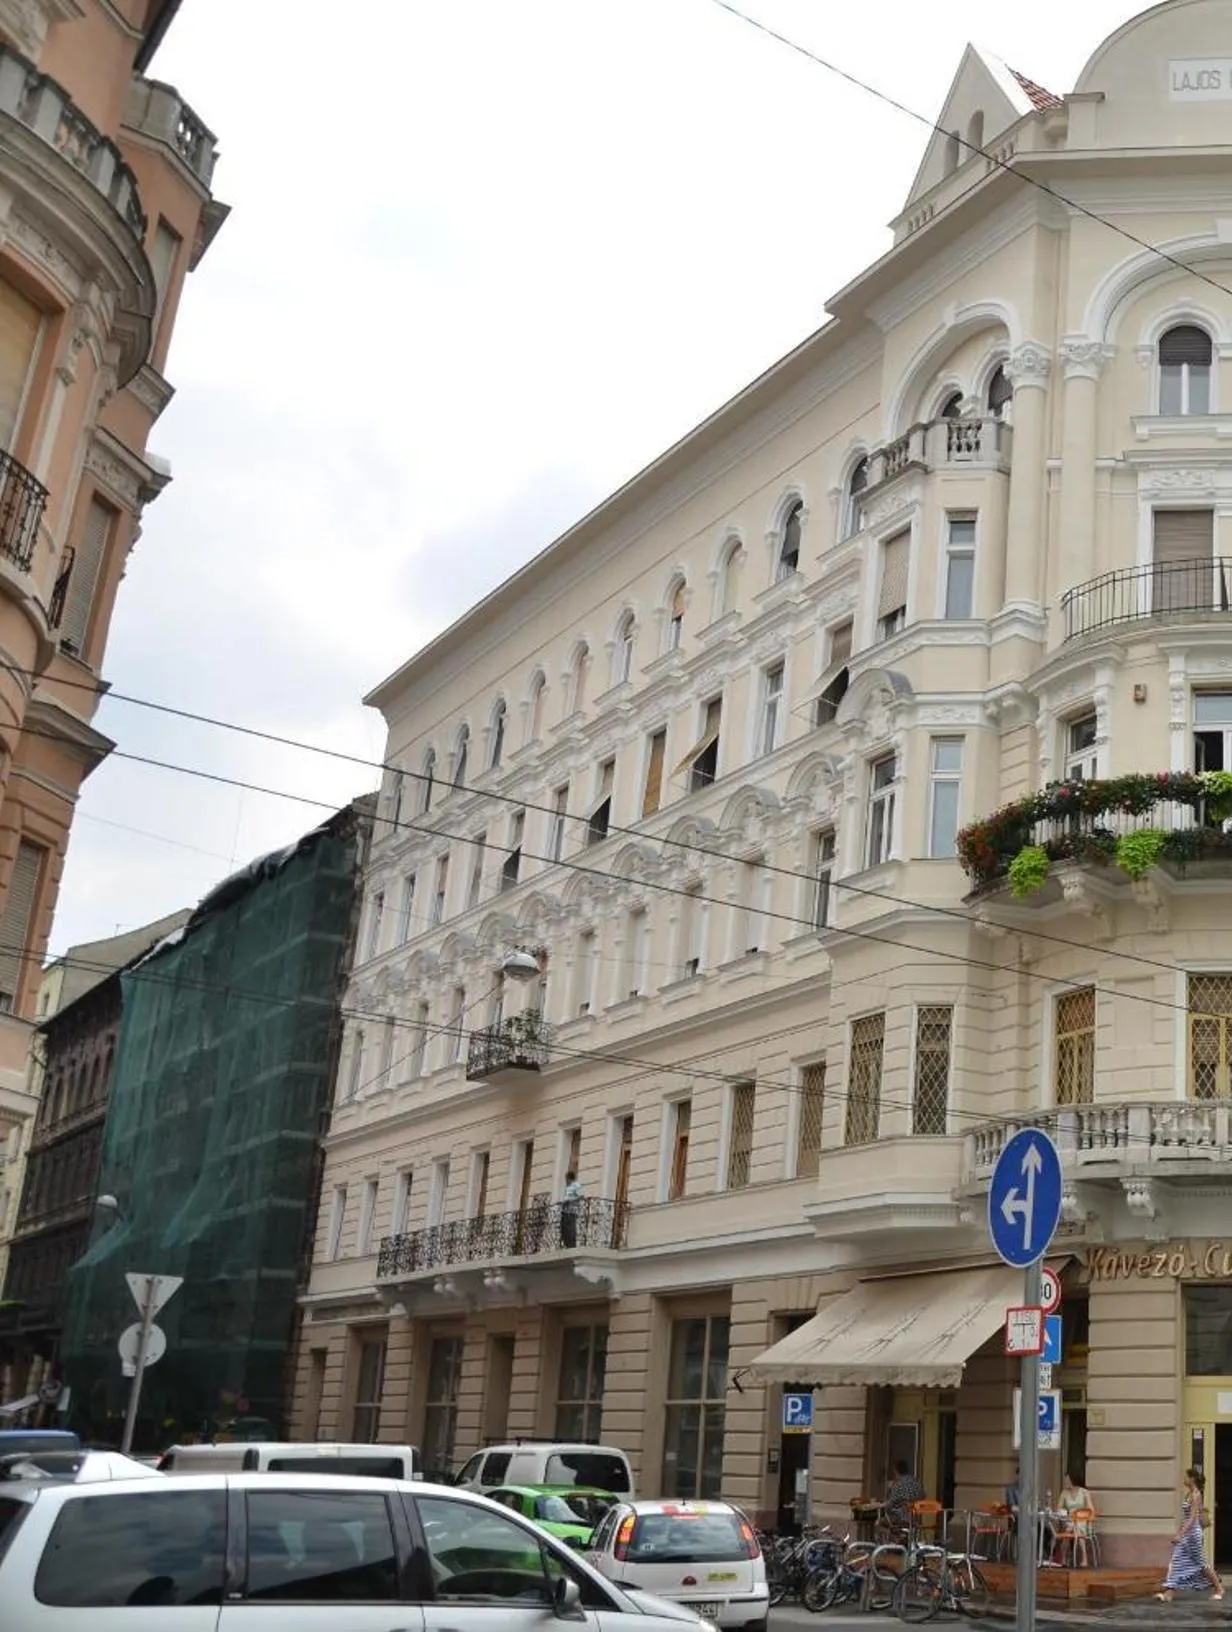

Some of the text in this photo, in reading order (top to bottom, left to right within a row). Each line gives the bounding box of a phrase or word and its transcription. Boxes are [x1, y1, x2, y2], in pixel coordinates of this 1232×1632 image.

[1172, 69, 1221, 92] LAJOS
[1041, 1283, 1051, 1300] 0
[786, 1397, 802, 1422] P
